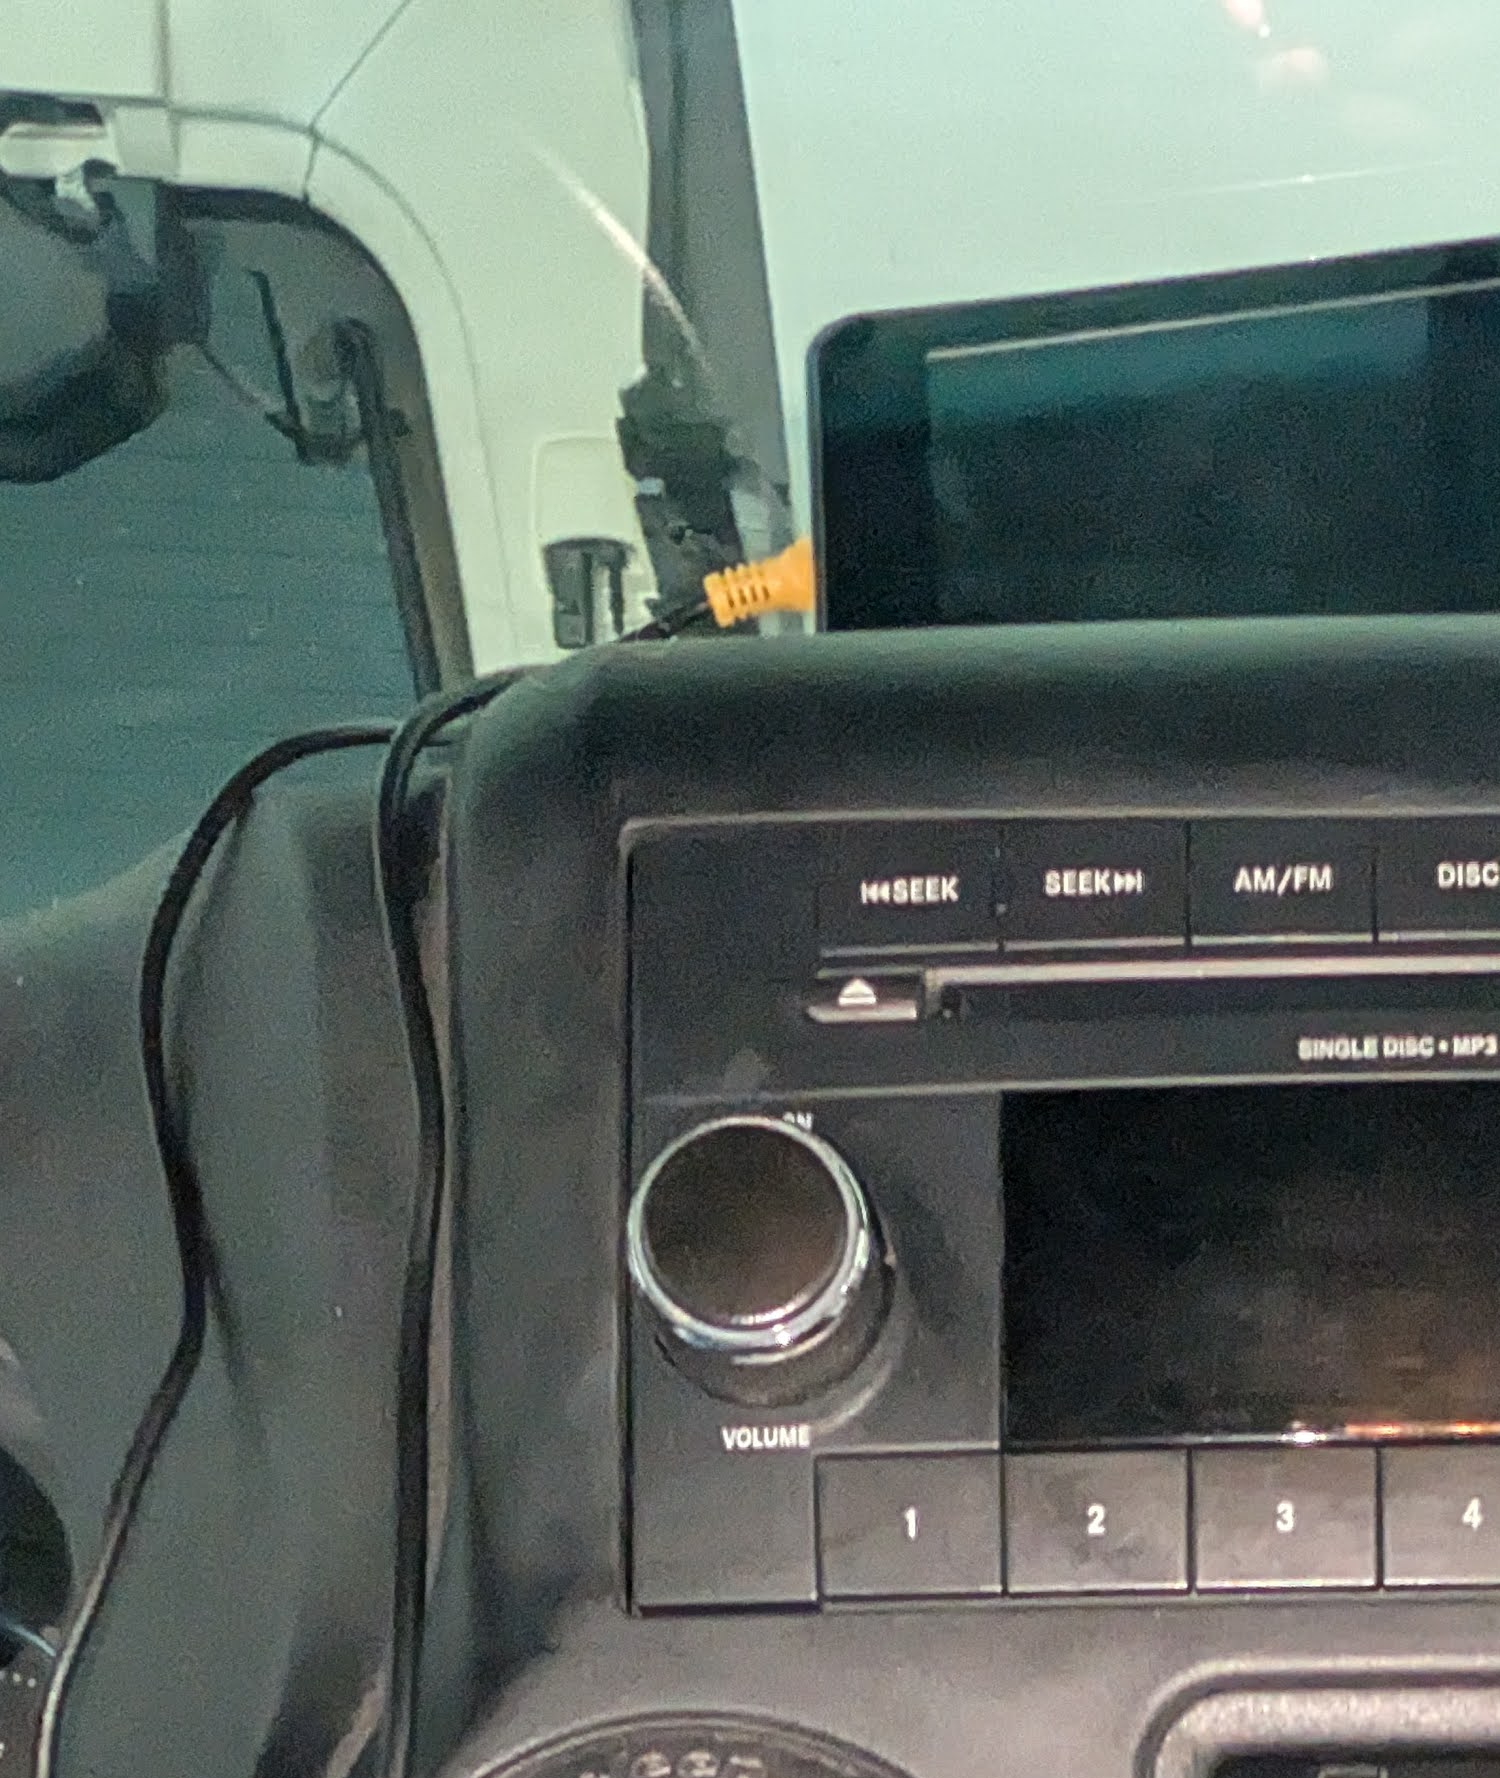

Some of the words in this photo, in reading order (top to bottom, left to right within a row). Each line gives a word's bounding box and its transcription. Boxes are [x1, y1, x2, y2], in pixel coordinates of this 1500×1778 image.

[891, 875, 960, 905] SEEK
[1045, 869, 1113, 898] SEEK
[1233, 864, 1333, 897] AM/FM
[1436, 860, 1500, 889] DISC
[1298, 1037, 1379, 1060] SINGLE
[1382, 1036, 1435, 1058] DISC
[1451, 1034, 1497, 1057] MP3
[720, 1422, 814, 1451] VOLUME
[903, 1506, 918, 1541] 1
[1086, 1502, 1107, 1537] 2
[1275, 1499, 1296, 1535] 3
[1460, 1496, 1484, 1532] 4
